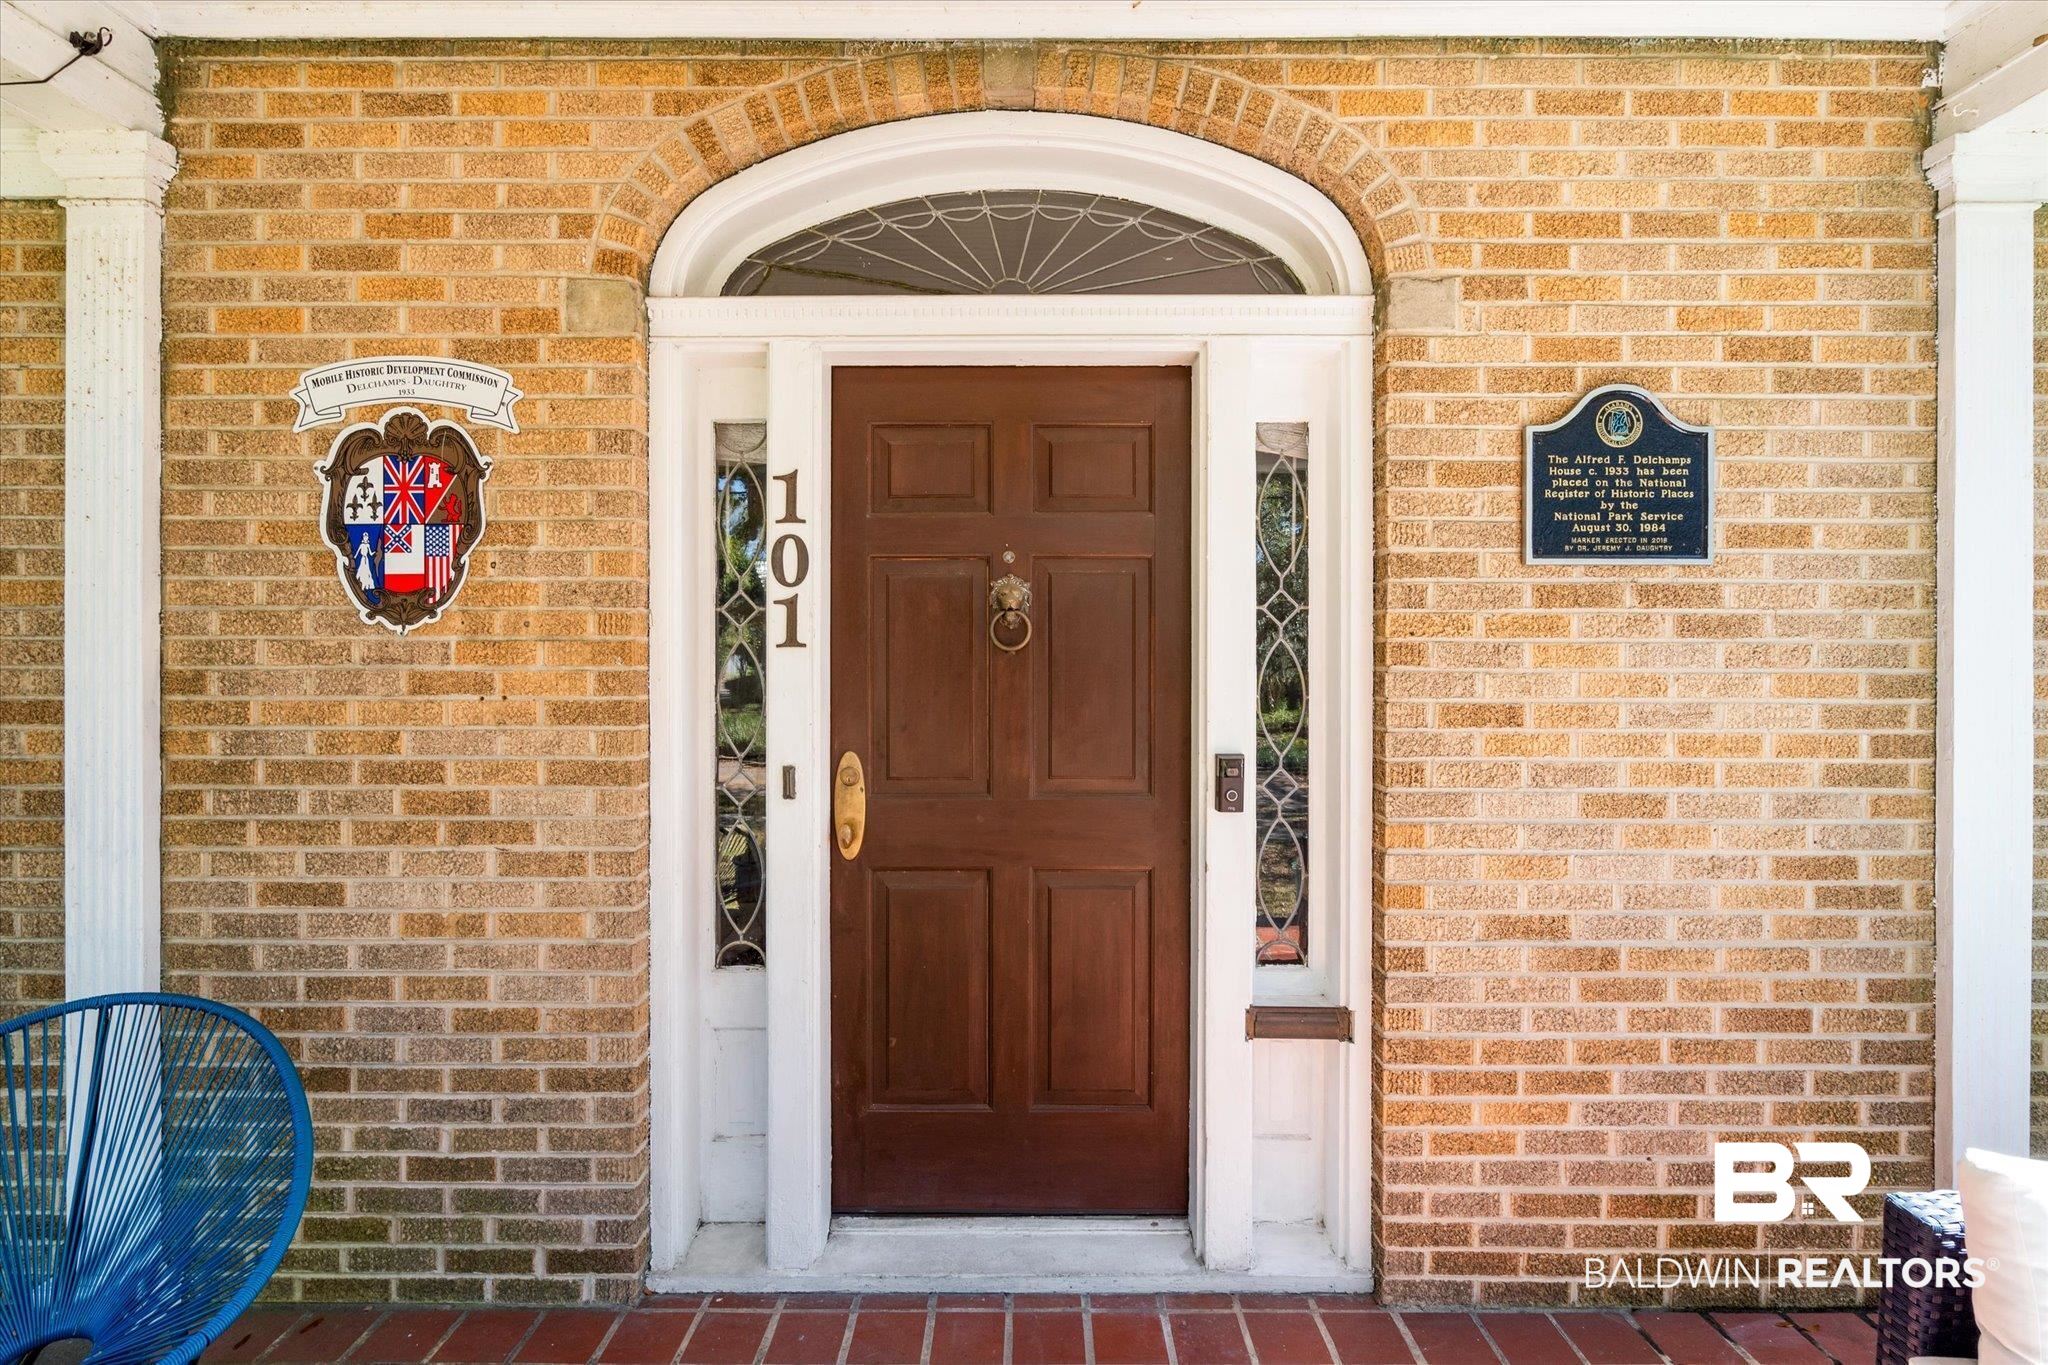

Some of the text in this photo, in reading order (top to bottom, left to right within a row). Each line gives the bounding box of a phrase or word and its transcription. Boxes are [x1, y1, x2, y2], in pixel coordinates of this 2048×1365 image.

[311, 364, 499, 389] MOBILE HISTORIC DEVELOPMENT COMMISSION
[346, 378, 406, 394] DELCHAMPS
[412, 376, 467, 391] DAUGHTRY
[1548, 455, 1692, 466] The Alfred F. Delchamps
[1550, 467, 1581, 476] House
[1605, 467, 1629, 476] 1933
[1636, 467, 1654, 476] has
[1663, 467, 1689, 476] been
[1552, 478, 1588, 488] placed
[1615, 478, 1632, 487] the
[1640, 478, 1686, 487] National
[1545, 490, 1694, 500] Register of Historic Places
[1600, 501, 1638, 510] by the
[1554, 512, 1683, 521] National Park Service
[1572, 524, 1610, 533] August
[1640, 524, 1666, 532] 1984
[773, 468, 809, 648] 101
